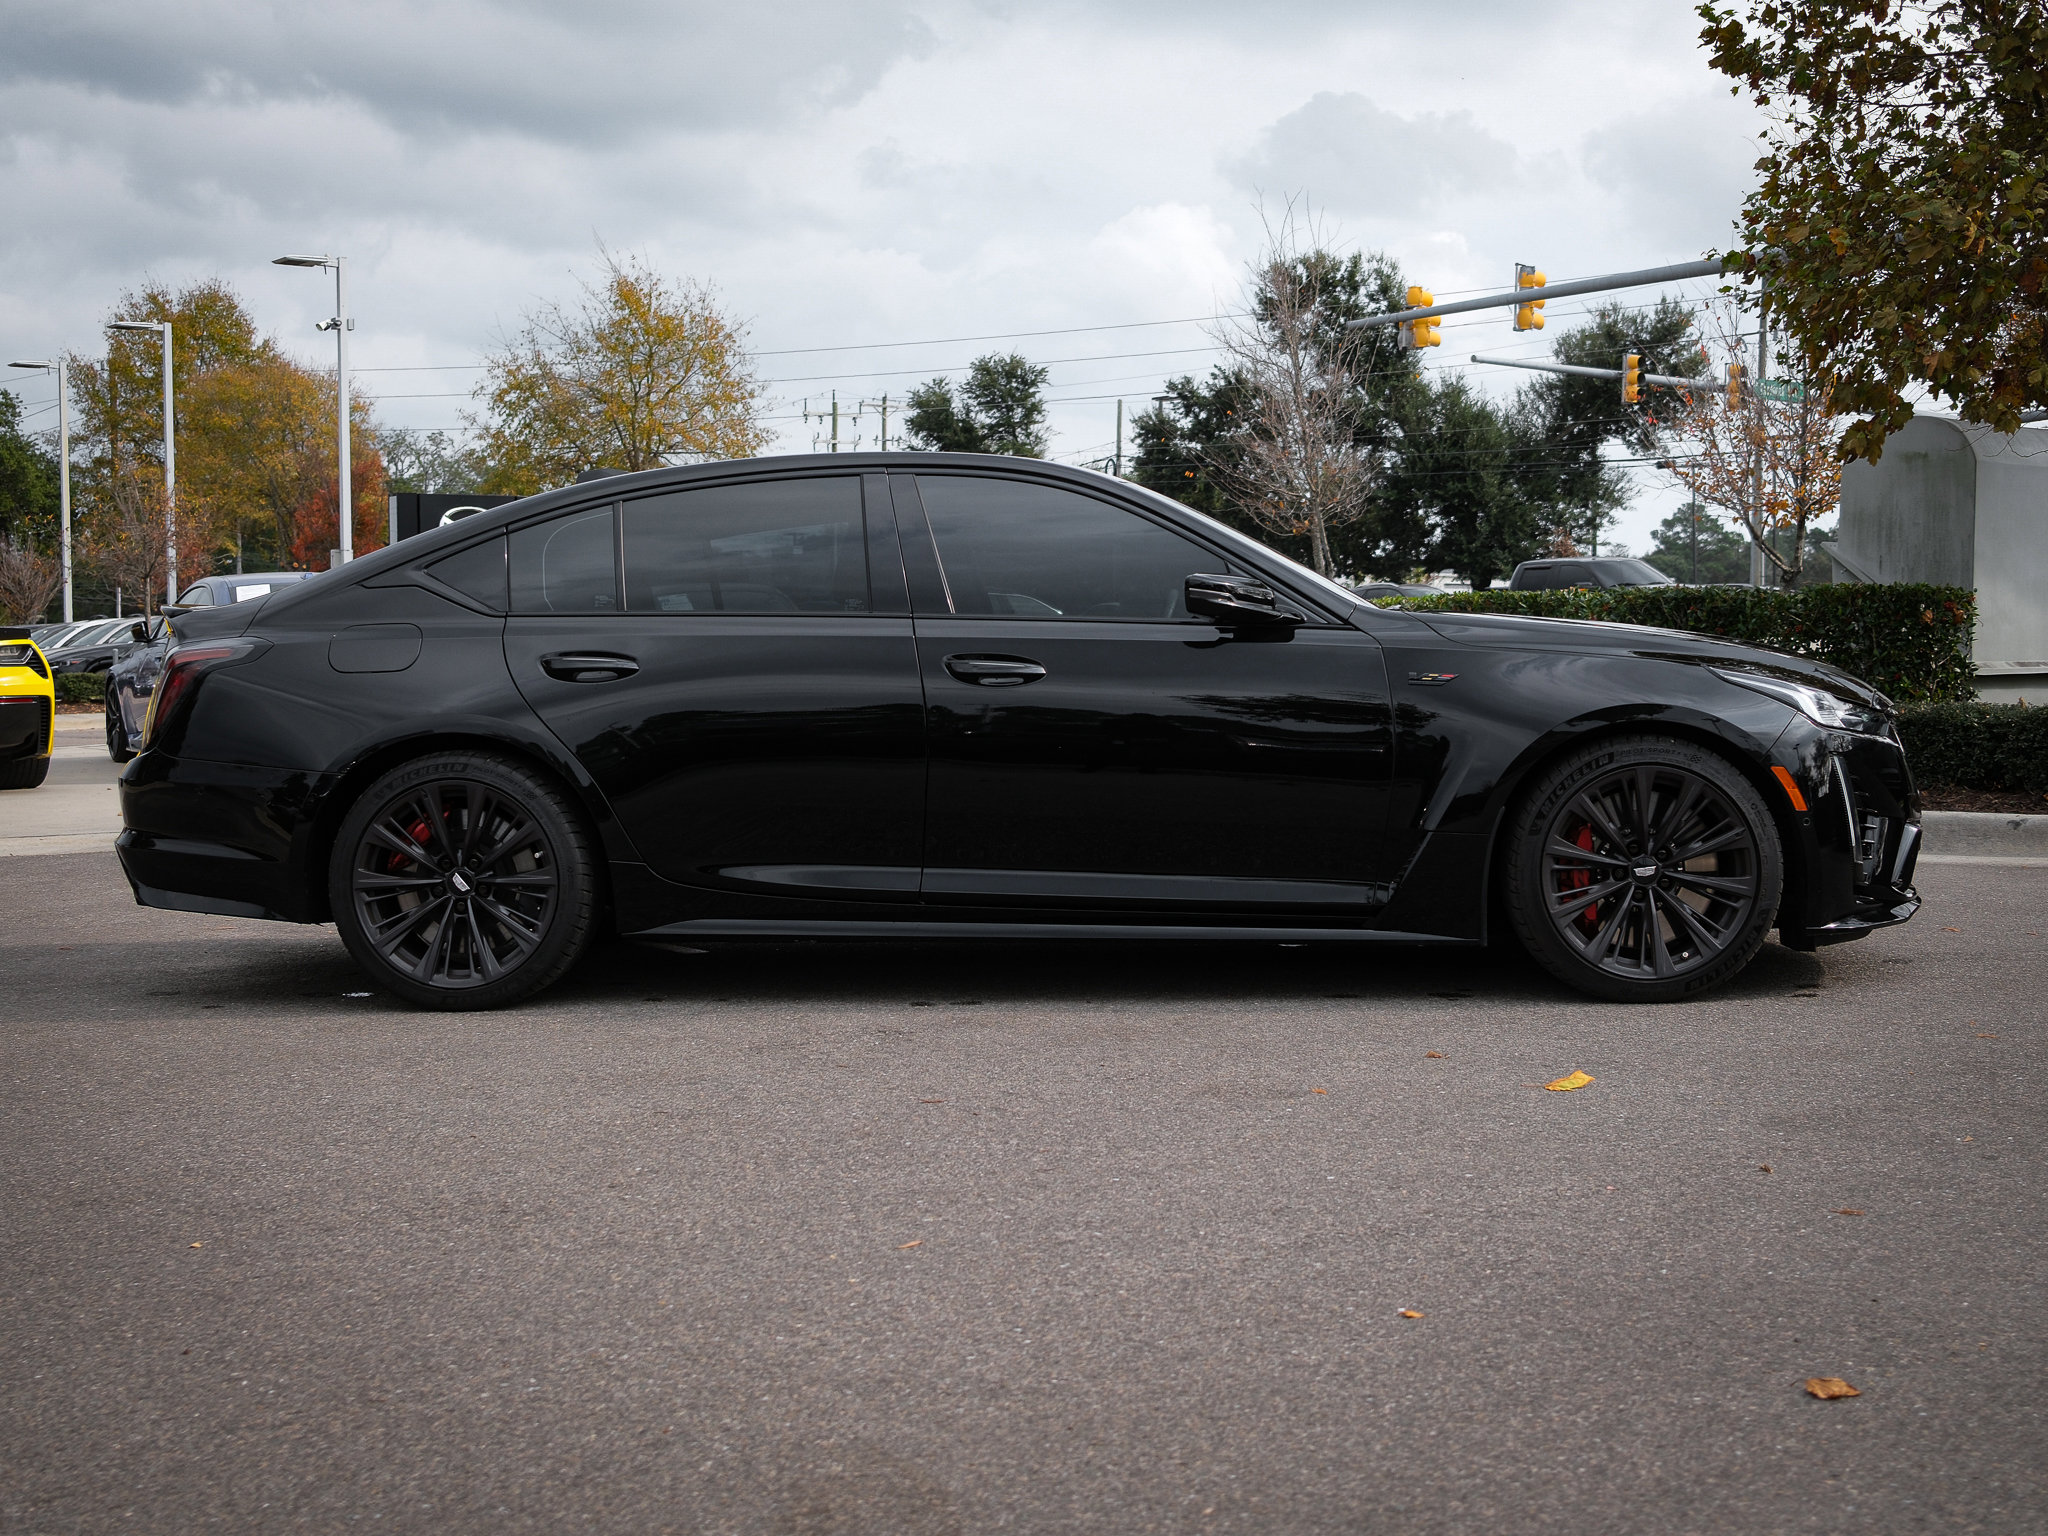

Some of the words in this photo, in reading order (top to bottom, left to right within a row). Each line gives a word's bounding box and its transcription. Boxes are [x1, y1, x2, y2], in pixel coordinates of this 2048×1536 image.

[1646, 747, 1676, 755] SPORT
[393, 763, 464, 790] MICHELIN
[1541, 753, 1610, 816] MICHELIN
